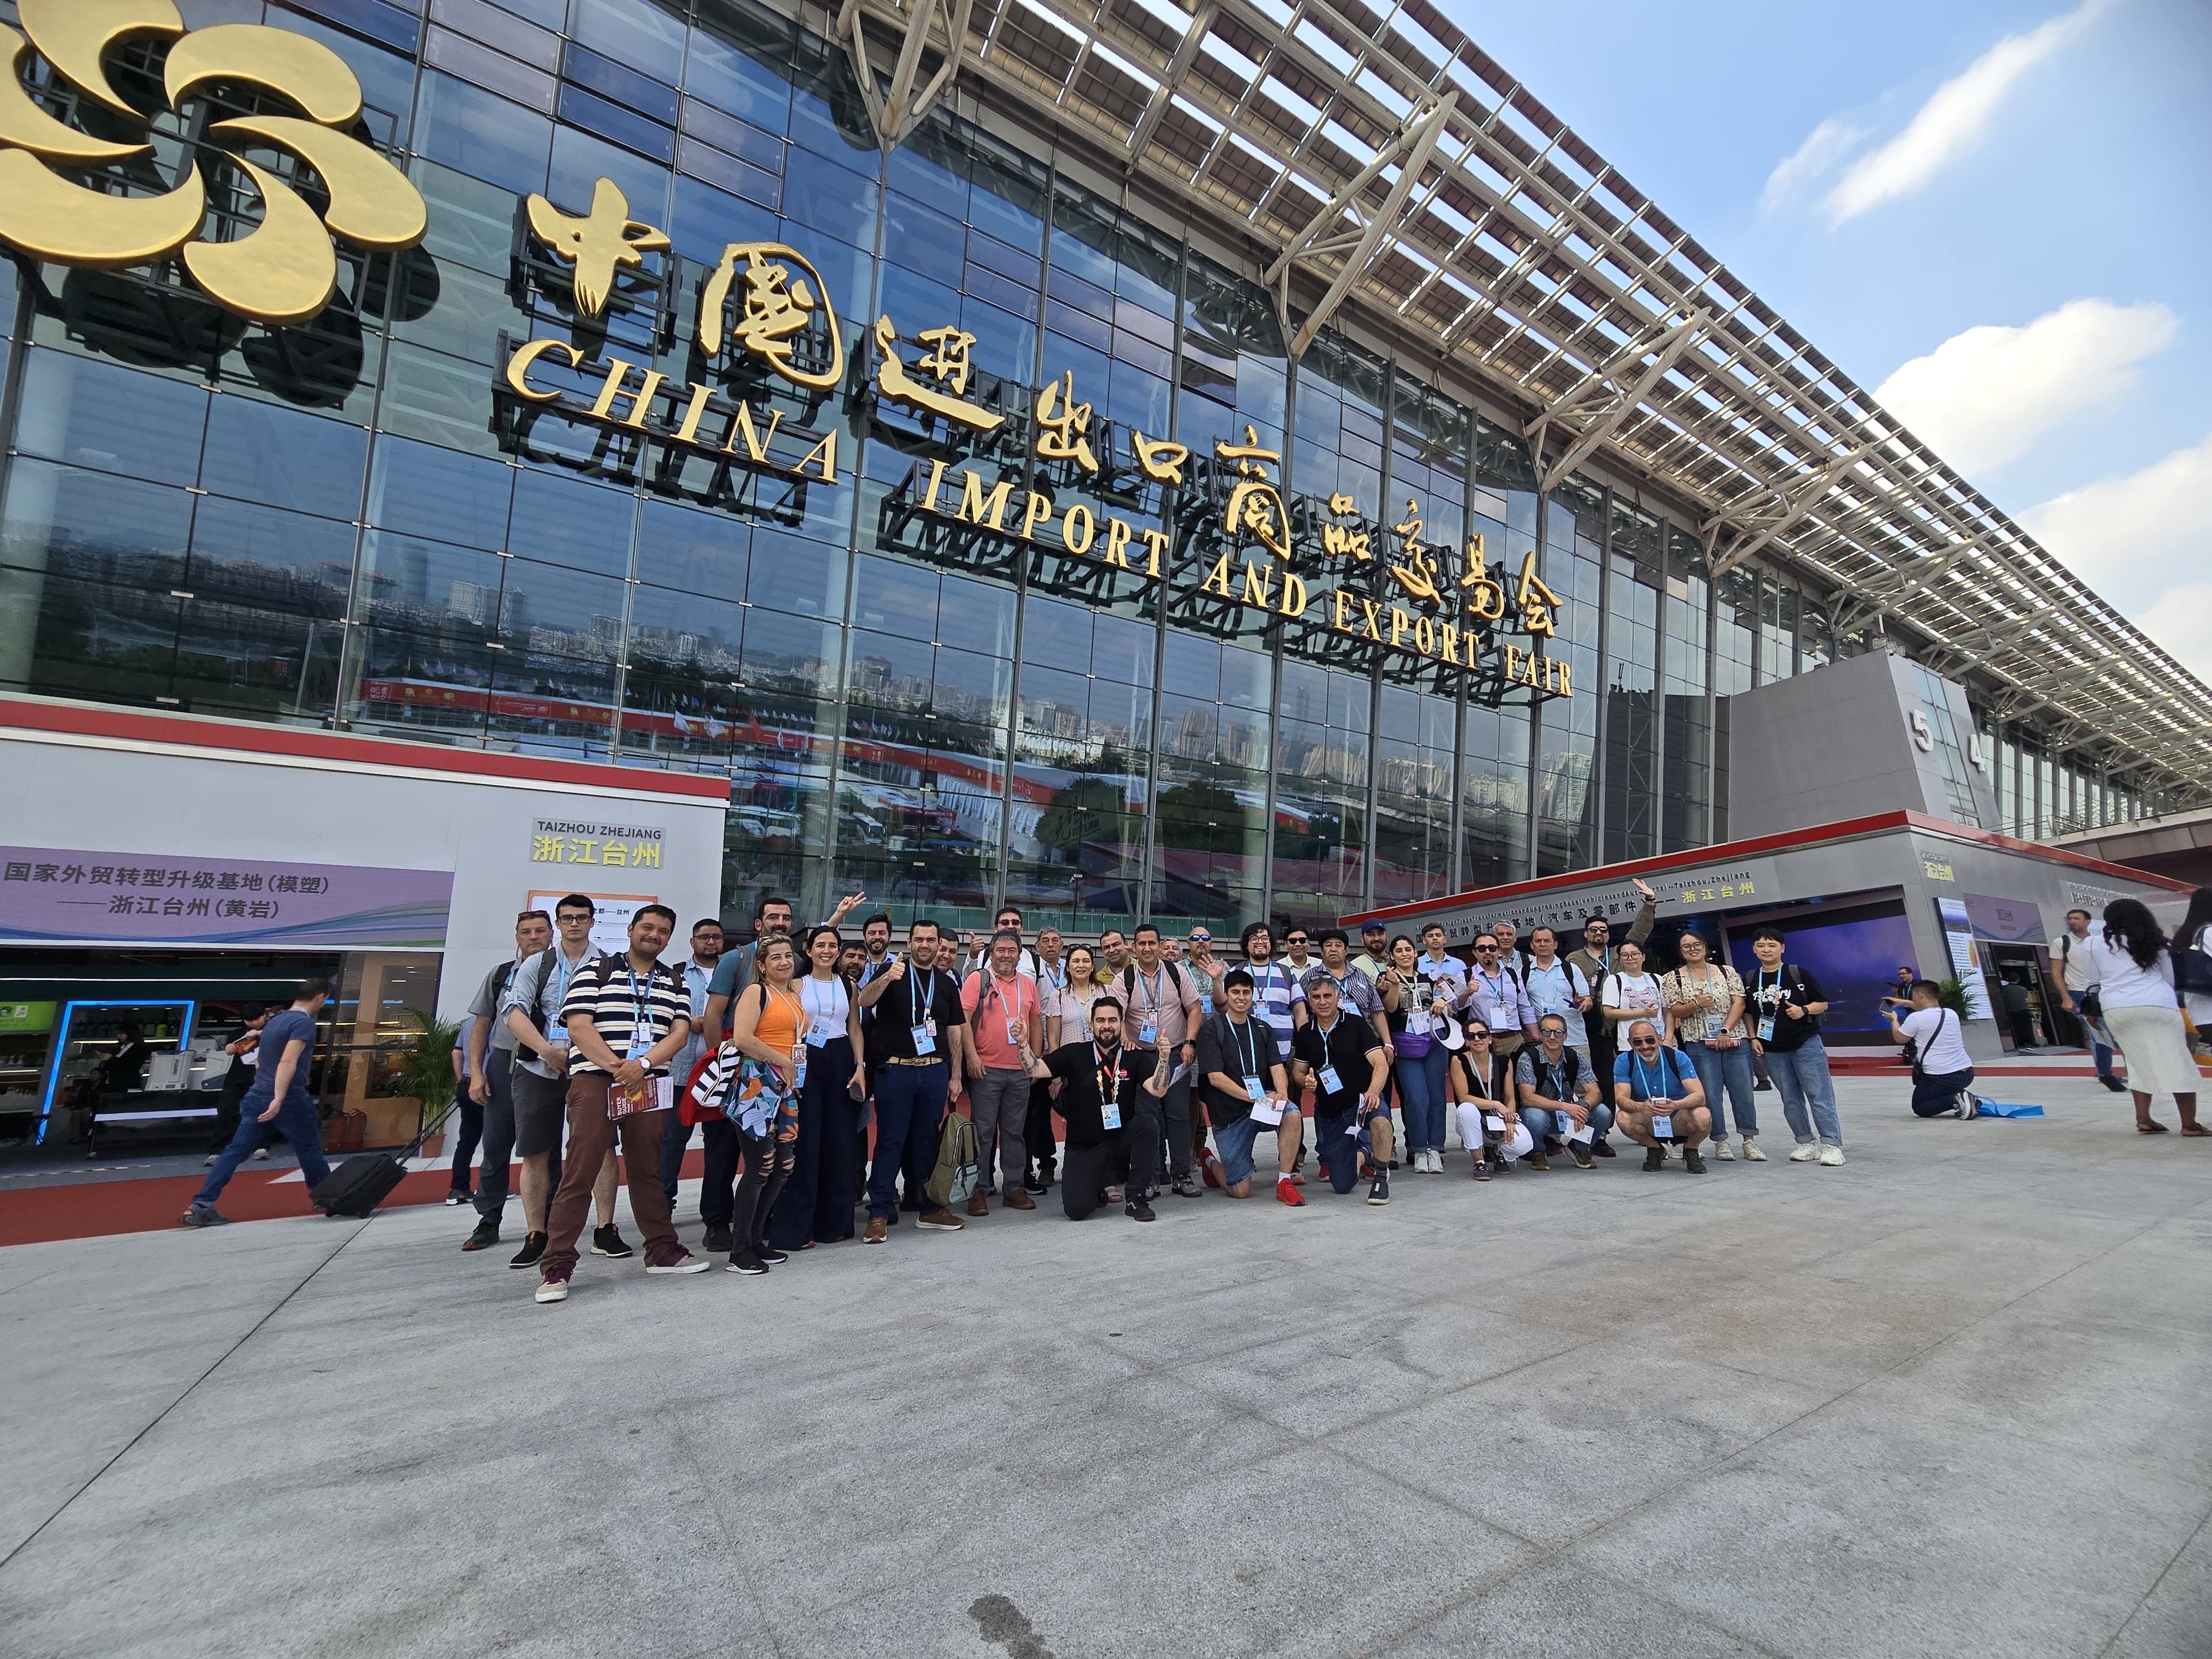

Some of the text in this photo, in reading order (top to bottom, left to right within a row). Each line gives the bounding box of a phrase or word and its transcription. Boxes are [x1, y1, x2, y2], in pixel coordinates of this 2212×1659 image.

[506, 338, 1574, 698] CHINA IMPORT AND EXPORT FAIR
[1910, 709, 1934, 752] 5
[1968, 733, 1987, 773] 4
[537, 821, 662, 839] TAIZHOU ZHEJIANG
[531, 834, 660, 869] 浙江台州
[3, 861, 330, 895] 国家外贸转型升级基地（模塑）
